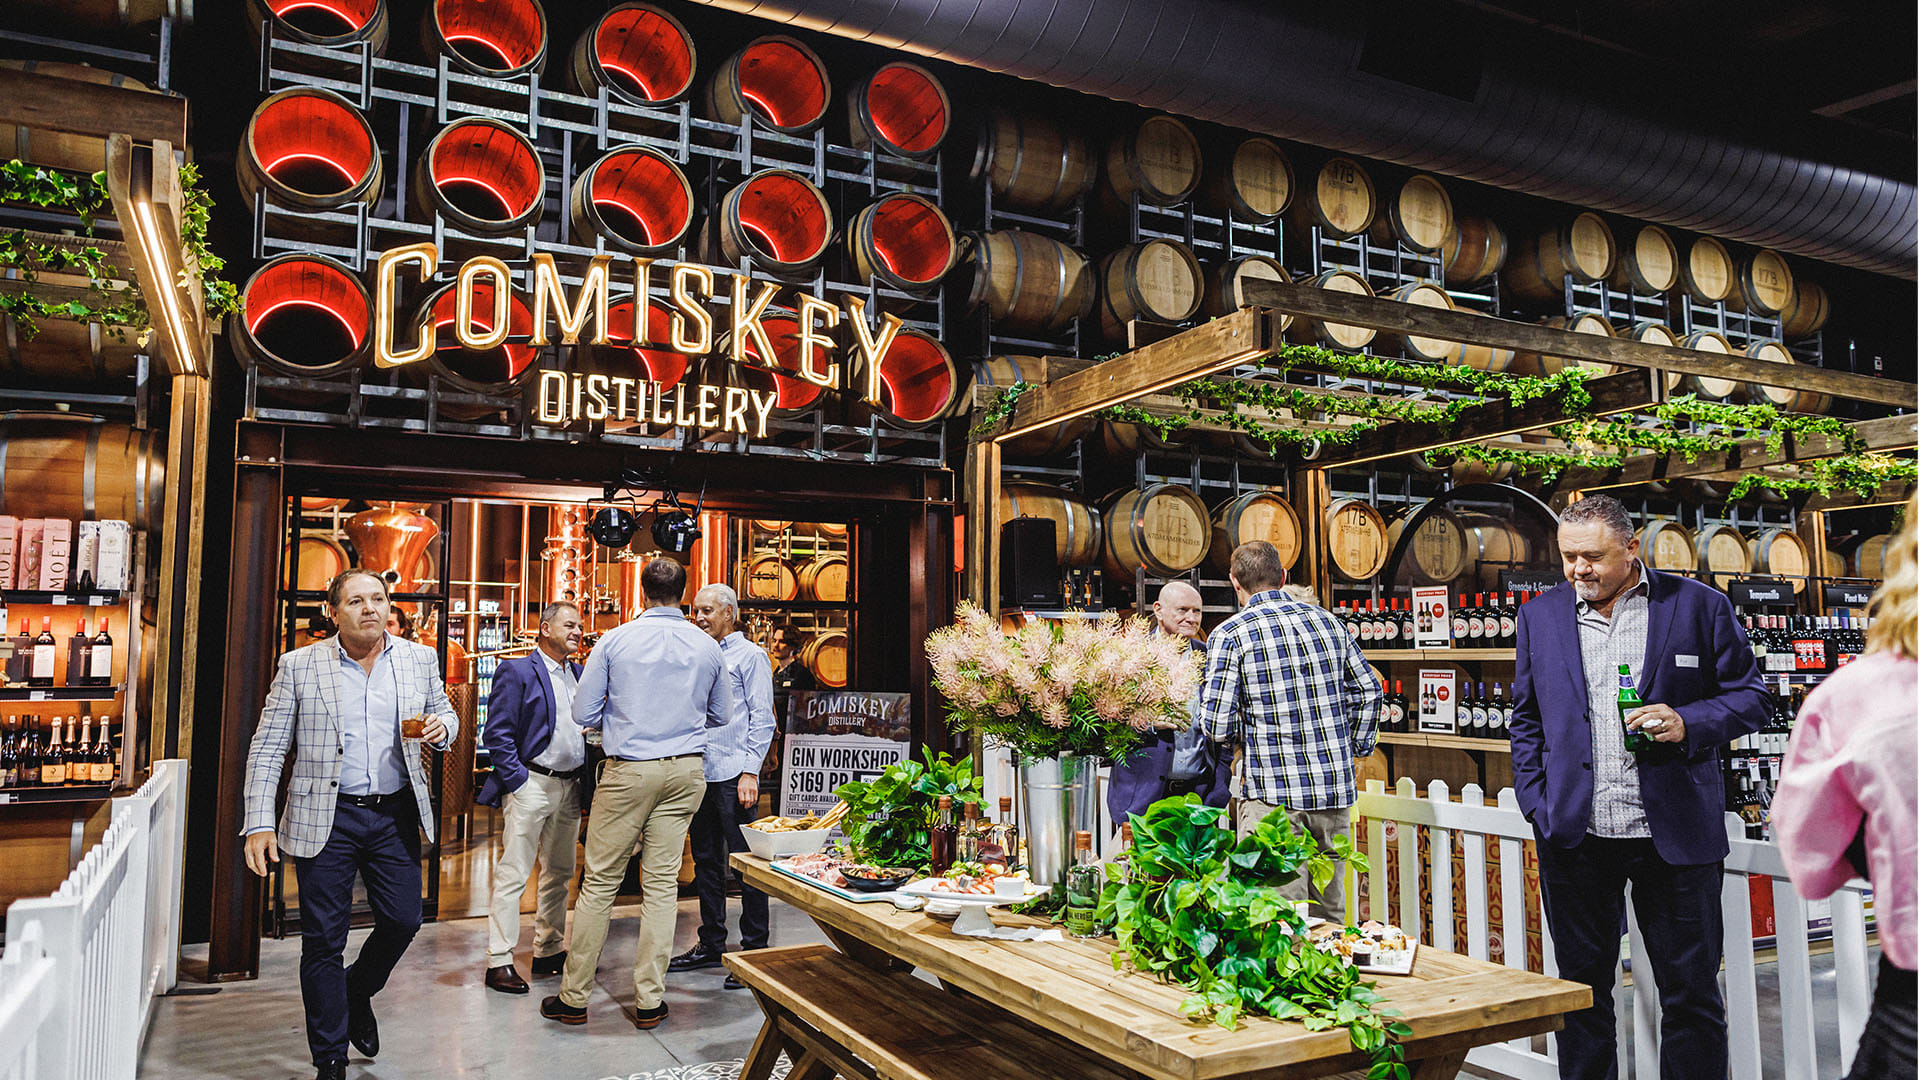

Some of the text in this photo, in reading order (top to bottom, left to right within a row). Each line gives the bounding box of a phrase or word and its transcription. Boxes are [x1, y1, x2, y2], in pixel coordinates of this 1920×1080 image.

[375, 243, 904, 407] COMISKEY
[537, 368, 778, 439] DISTILLERY
[1346, 507, 1367, 526] 17B
[807, 695, 890, 720] COMISKEY
[828, 716, 866, 727] DISTILLERY
[791, 747, 899, 769] GIN WORKSHOP
[790, 770, 824, 793] $169
